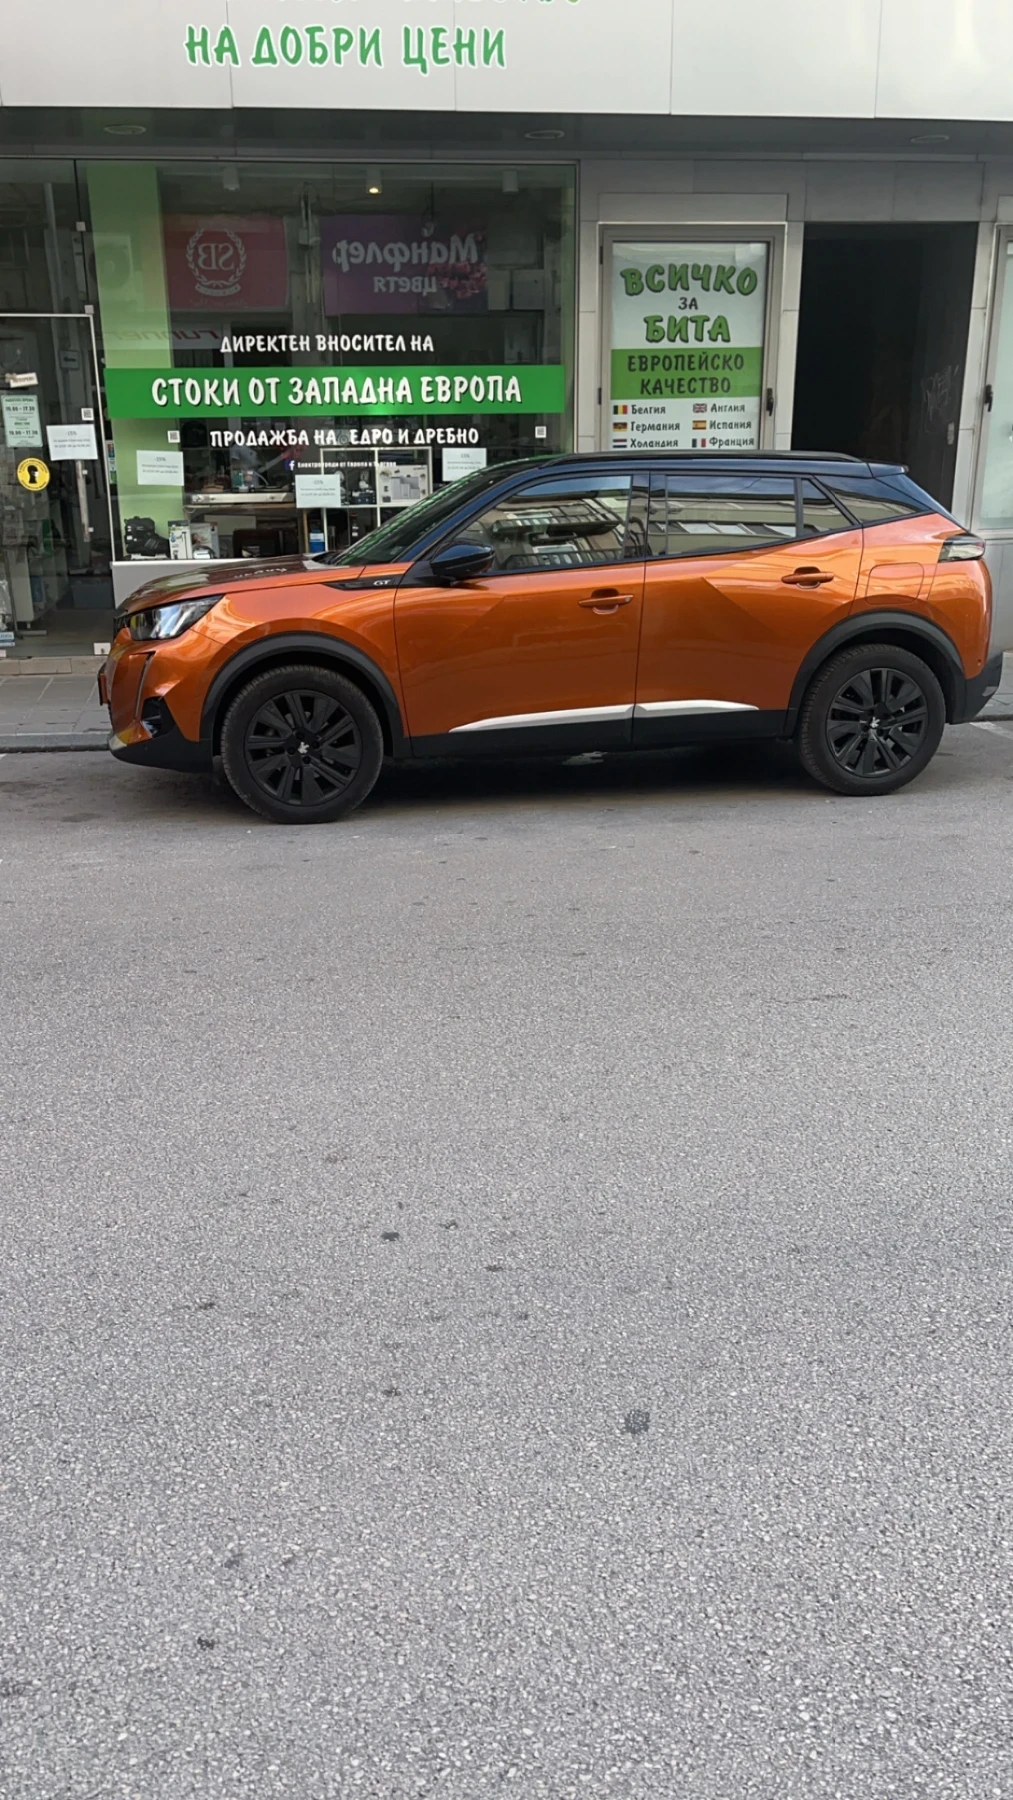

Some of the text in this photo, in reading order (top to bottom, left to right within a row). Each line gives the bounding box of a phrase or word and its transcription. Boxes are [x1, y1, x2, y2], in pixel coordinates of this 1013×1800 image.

[184, 25, 507, 75] НА ДОБРИ ЦЕНИ
[620, 263, 758, 296] ВСИЧКО
[678, 297, 698, 310] ЗА
[643, 315, 731, 343] БИТА
[220, 334, 434, 352] ДИРЕКТЕН ВНОСИТЕЛ НА
[627, 352, 744, 372] ЕВРОПЕЙСКО
[151, 375, 522, 407] СТОКИ ОТ ЗАПАДНА ЕВРОПА
[640, 377, 731, 395] КАЧЕСТВО
[631, 404, 666, 415] Белгия
[710, 403, 745, 413] Англия
[630, 421, 680, 433] Германия
[709, 420, 752, 430] Испания
[209, 427, 479, 447] ПРОДАЖБА НА ЕДРО И ДРЕБНО
[630, 438, 679, 448] Холандия
[709, 436, 755, 448] Франция
